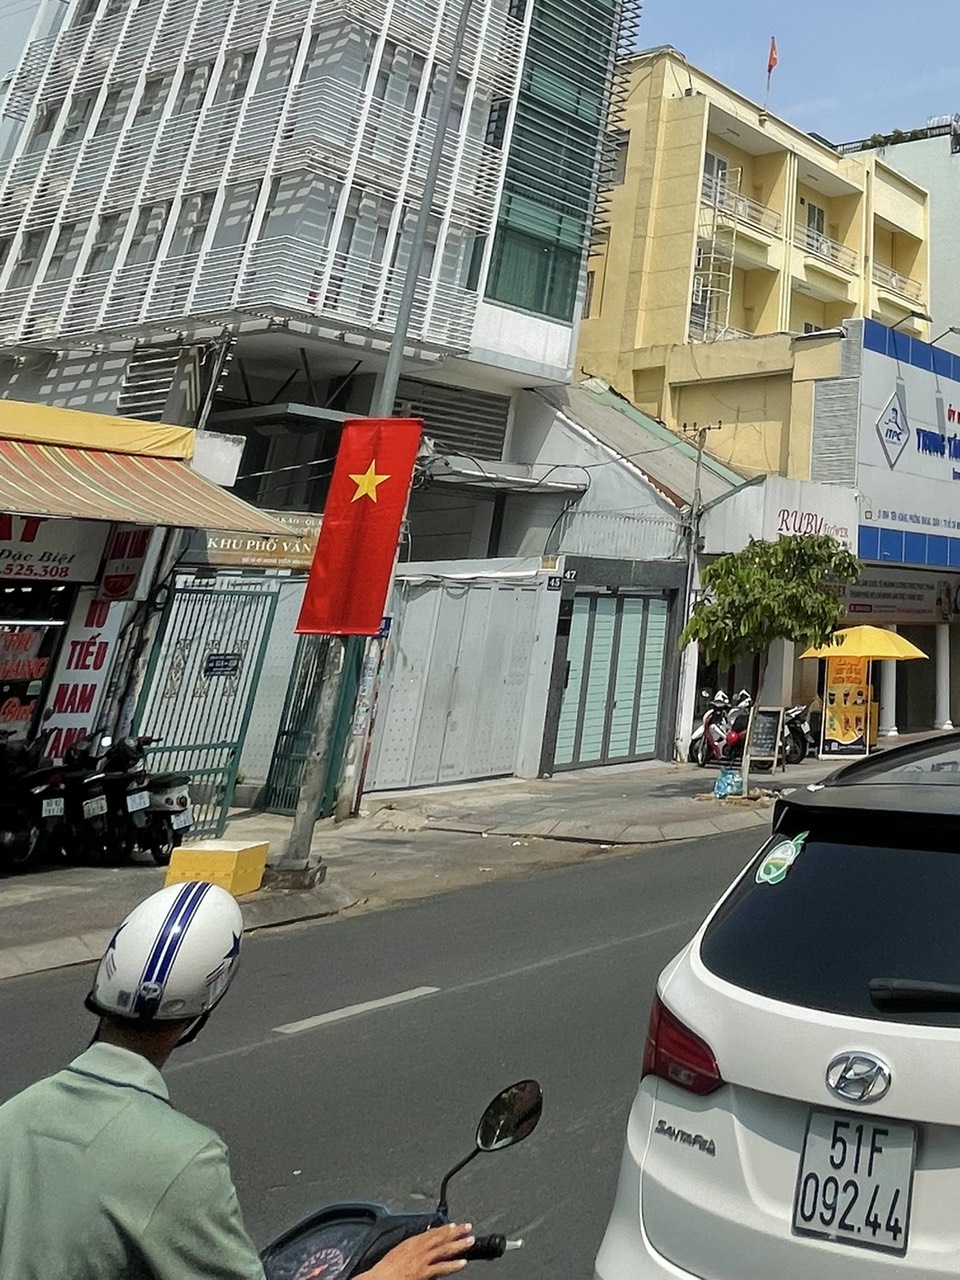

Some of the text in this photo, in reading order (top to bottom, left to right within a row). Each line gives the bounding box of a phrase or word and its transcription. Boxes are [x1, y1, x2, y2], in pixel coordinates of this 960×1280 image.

[207, 537, 242, 549] KHU
[246, 537, 279, 552] PHỐ
[550, 578, 560, 587] 45
[565, 570, 576, 579] 47
[53, 683, 97, 713] NAM
[829, 1121, 889, 1177] 51F
[800, 1172, 902, 1241] 092.44
